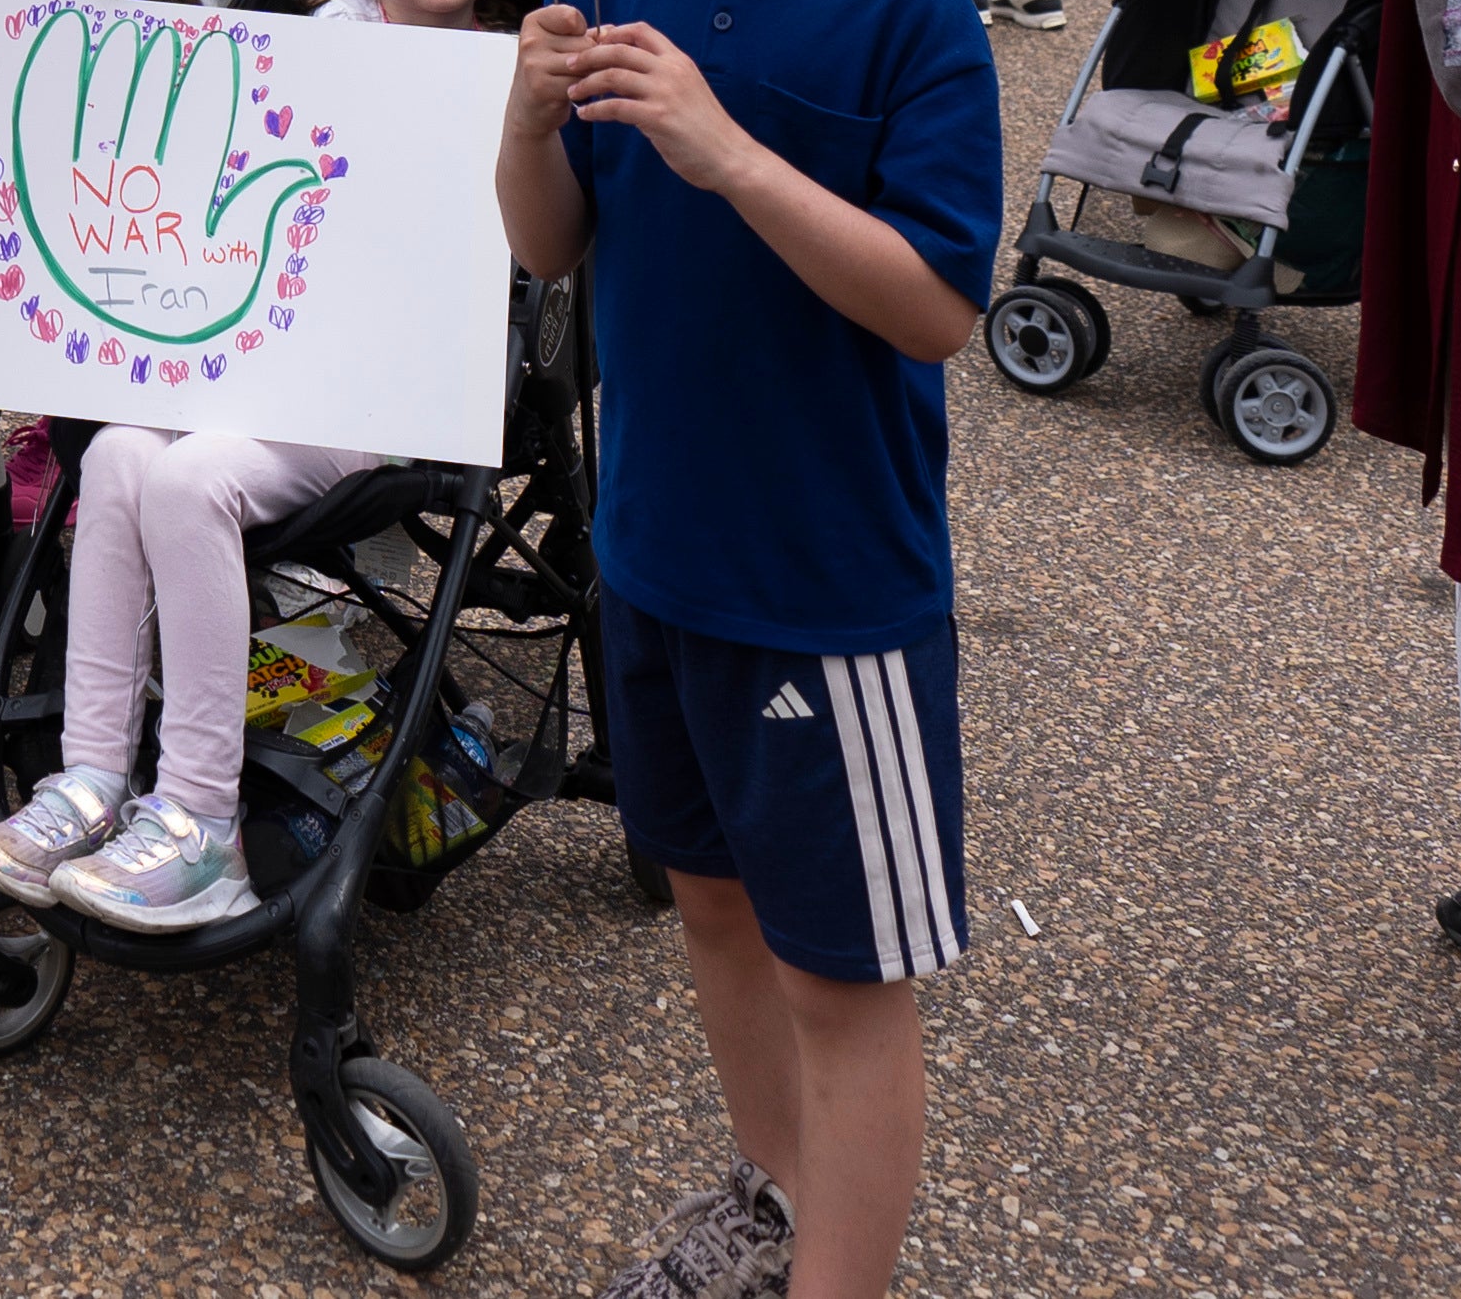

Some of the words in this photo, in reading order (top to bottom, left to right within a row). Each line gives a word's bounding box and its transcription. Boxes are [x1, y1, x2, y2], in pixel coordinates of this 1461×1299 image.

[71, 160, 162, 214] NO
[68, 212, 190, 266] WAR
[203, 240, 258, 268] with
[88, 267, 210, 311] Iran
[248, 656, 307, 689] ATCH
